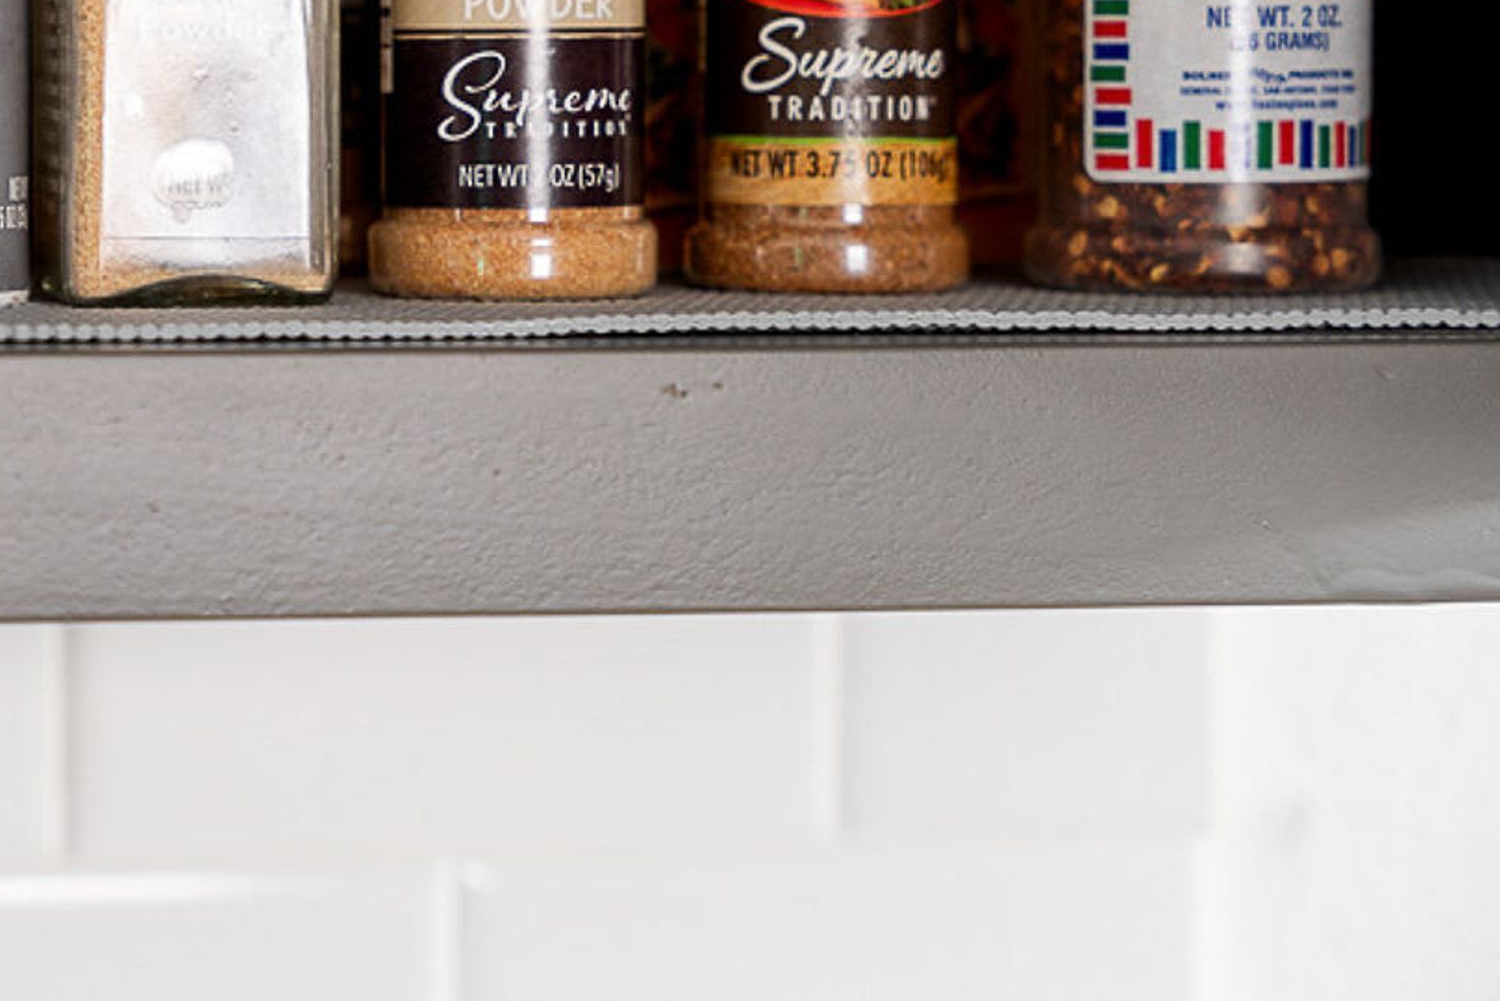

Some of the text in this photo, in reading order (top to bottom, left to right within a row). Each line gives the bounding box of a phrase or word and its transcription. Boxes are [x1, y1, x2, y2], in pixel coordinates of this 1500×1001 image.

[1257, 4, 1296, 28] WT.
[1302, 5, 1313, 28] 2
[740, 17, 943, 97] Supreme
[768, 95, 929, 121] TRADITION
[458, 162, 620, 193] NET WT OZ (57g)
[767, 151, 798, 178] WT
[865, 151, 893, 178] OZ
